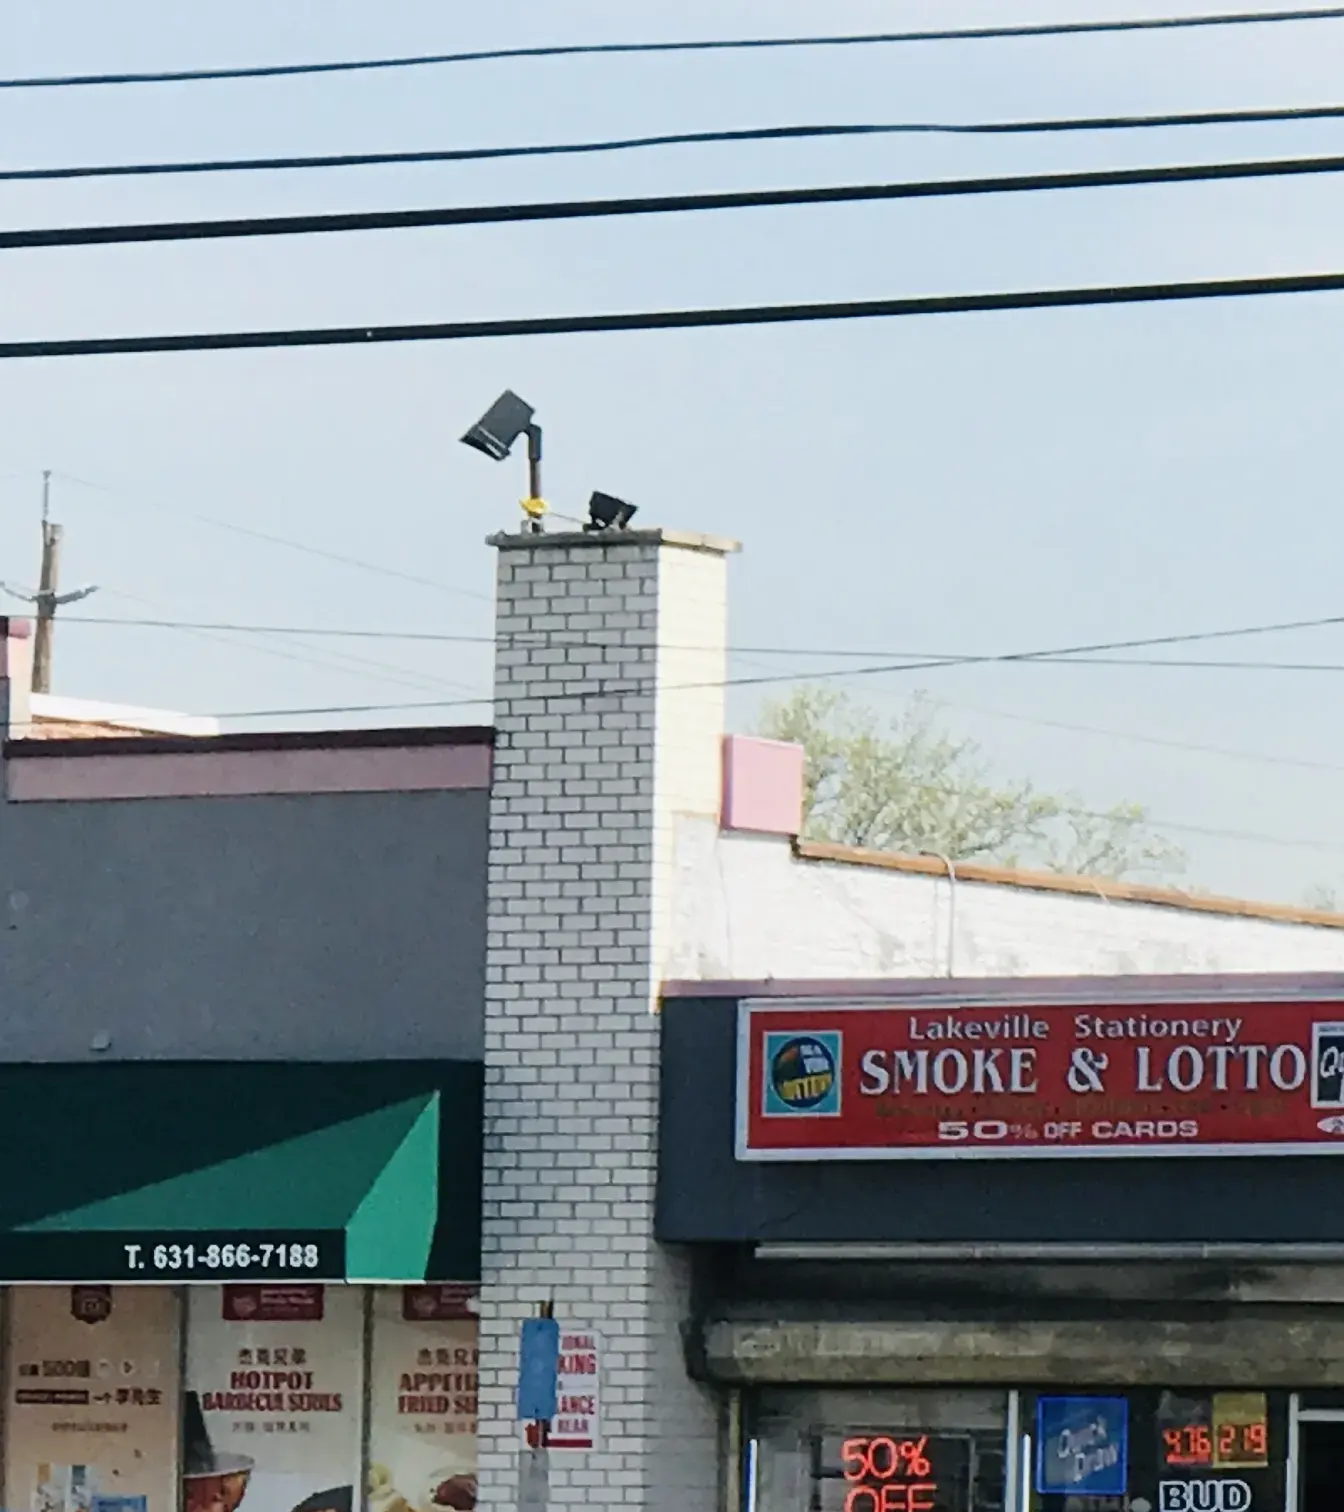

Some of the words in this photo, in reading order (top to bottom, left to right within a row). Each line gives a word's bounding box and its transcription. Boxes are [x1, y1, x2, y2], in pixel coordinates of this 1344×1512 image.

[910, 1014, 1050, 1040] Lakeville
[1074, 1013, 1242, 1042] Stationery
[860, 1047, 1039, 1095] SMOKE
[1067, 1047, 1109, 1092] &
[1136, 1044, 1306, 1091] LOTTO
[938, 1120, 1038, 1140] 50%
[1044, 1121, 1082, 1139] OFF
[1092, 1119, 1199, 1139] CARDS
[124, 1244, 145, 1269] T.
[154, 1243, 319, 1269] 631-866-7188
[230, 1371, 314, 1390] HOTPOT
[840, 1434, 931, 1481] 50%
